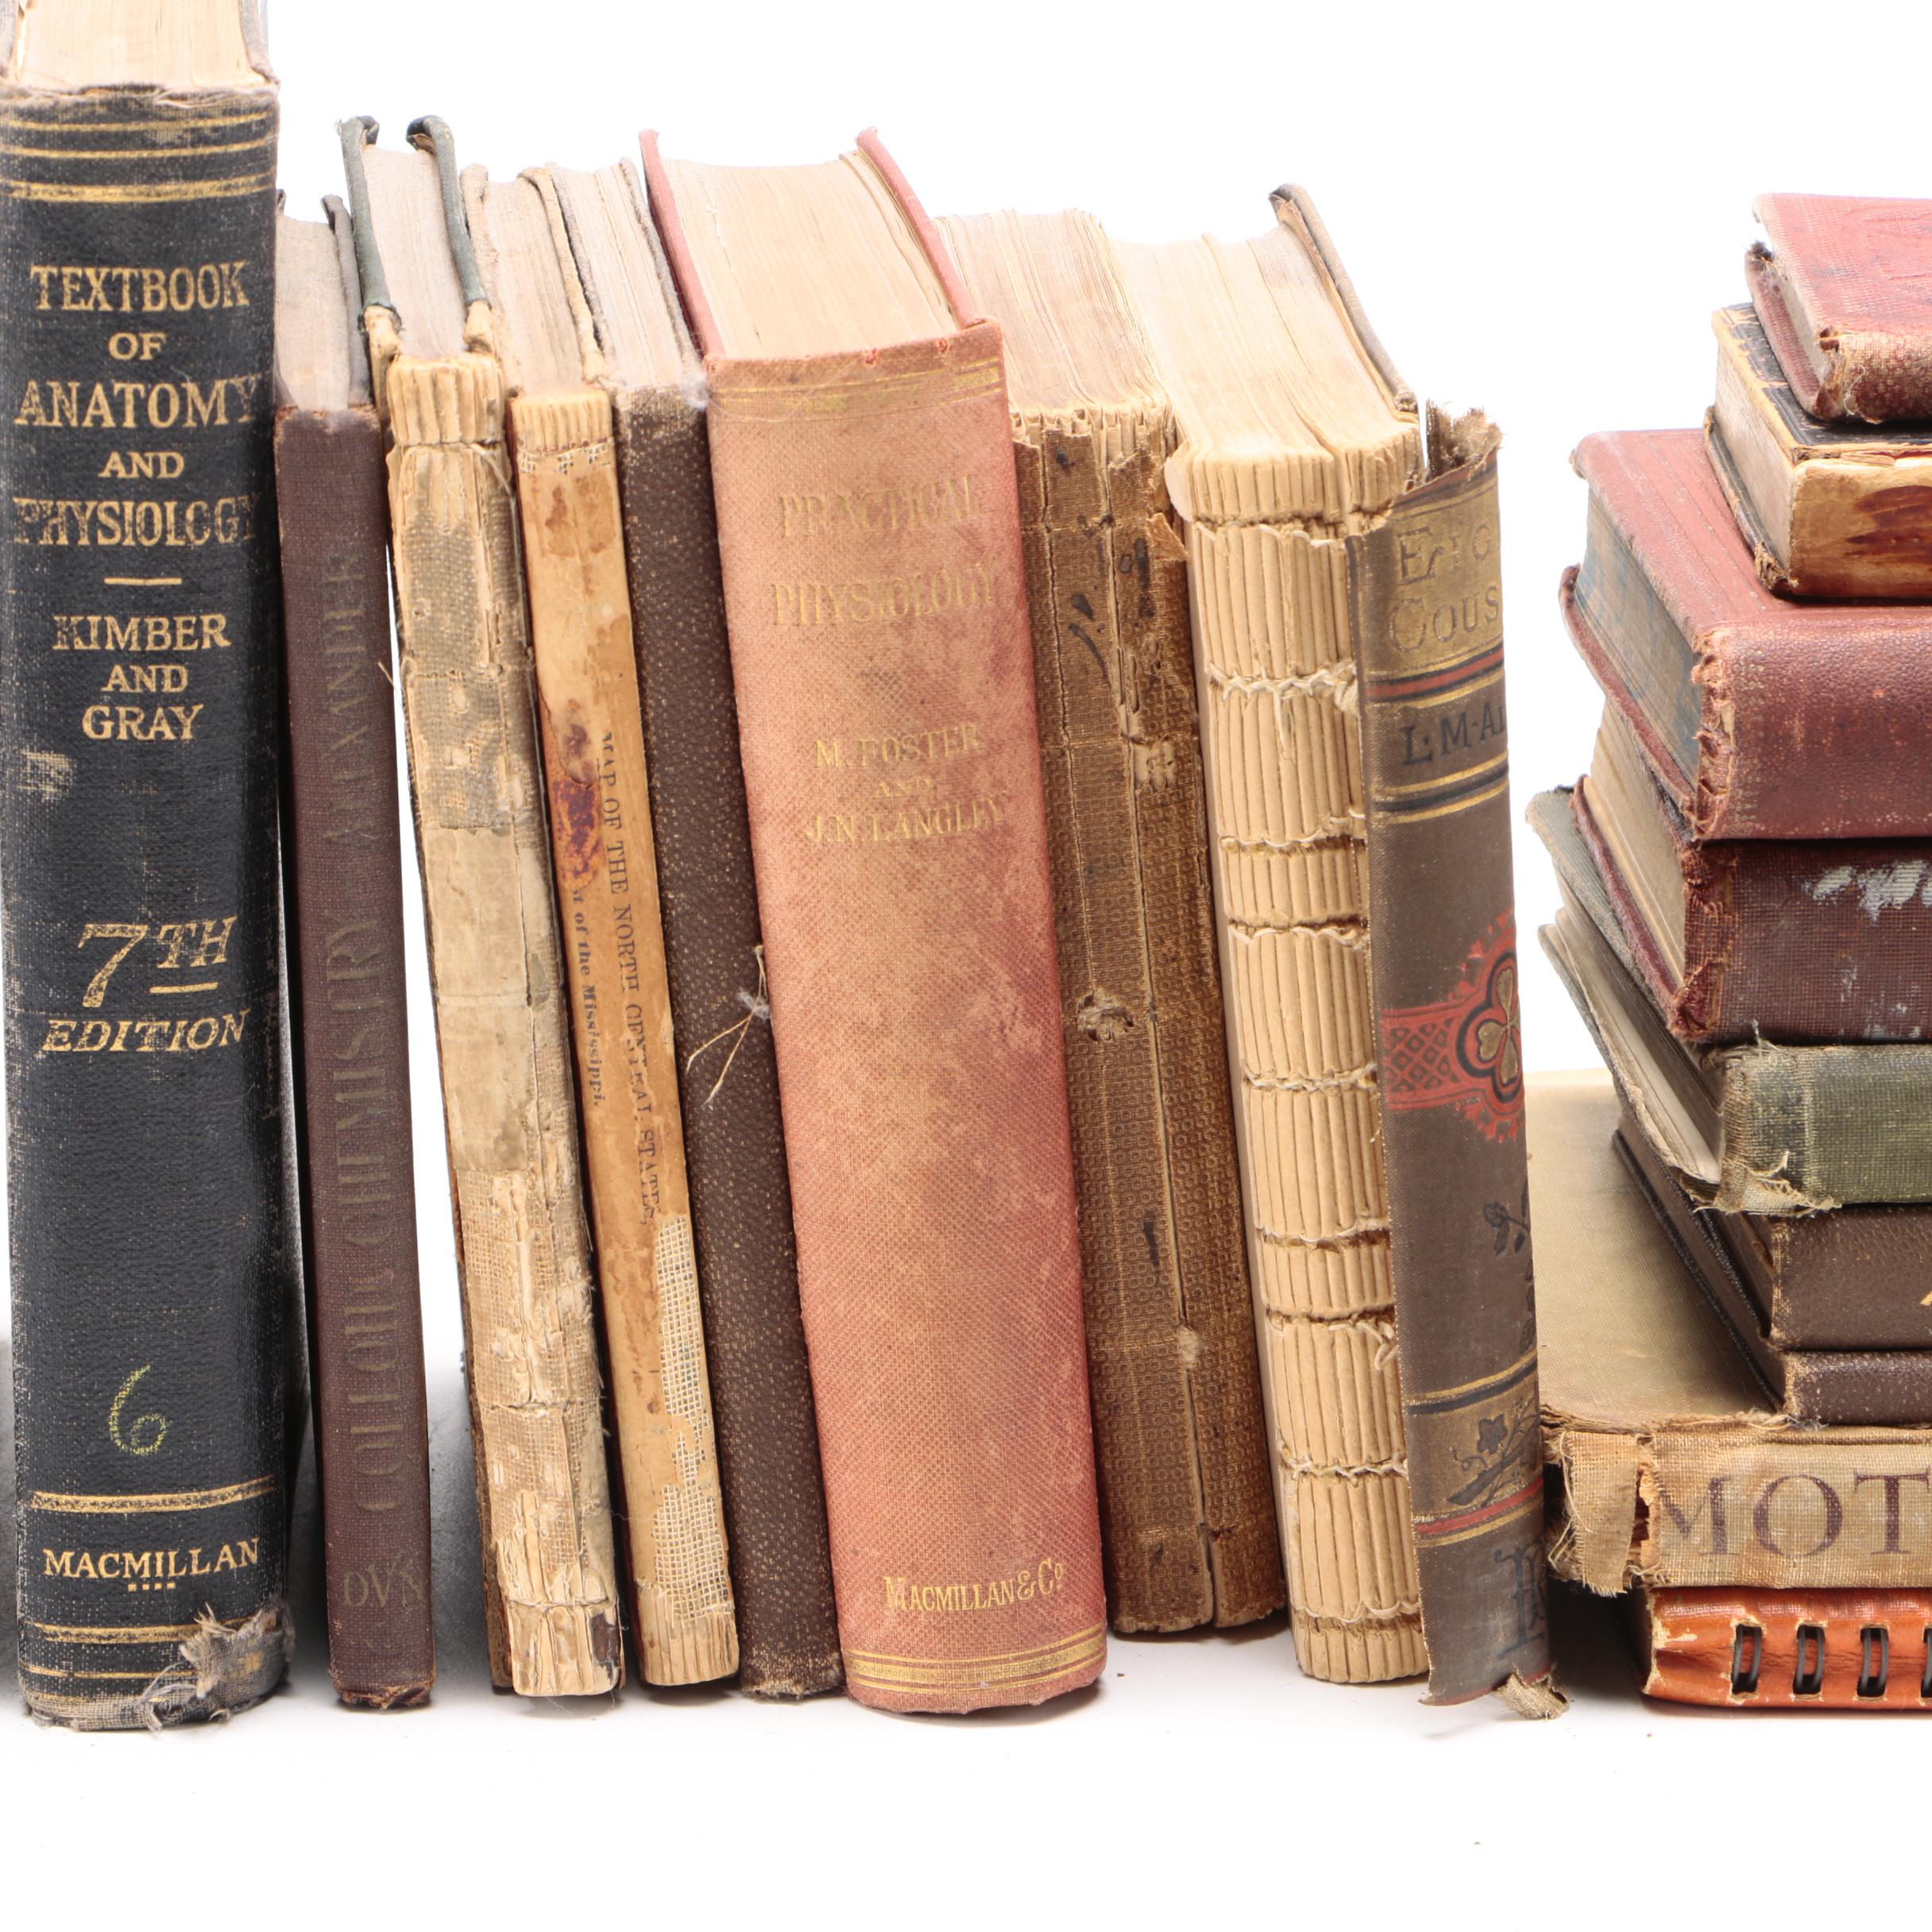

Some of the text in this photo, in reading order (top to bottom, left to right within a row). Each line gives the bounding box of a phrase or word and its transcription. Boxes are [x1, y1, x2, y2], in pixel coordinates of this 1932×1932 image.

[30, 261, 252, 313] TEXTBOOK
[108, 332, 168, 361] OF
[14, 372, 265, 429] ANATOMY
[99, 451, 185, 478] AND
[12, 491, 263, 546] PHYSIOLOGY
[52, 613, 230, 651] KIMBER
[1389, 585, 1499, 652] COUS
[101, 665, 188, 693] AND
[82, 704, 203, 740] GRAY
[602, 798, 623, 831] OF
[606, 840, 629, 895] THE
[574, 911, 592, 934] of
[578, 942, 596, 976] the
[612, 904, 640, 993] NORTH
[41, 1007, 252, 1055] EDITION
[109, 1363, 168, 1455] 6
[43, 1536, 260, 1582] MACMILLAN
